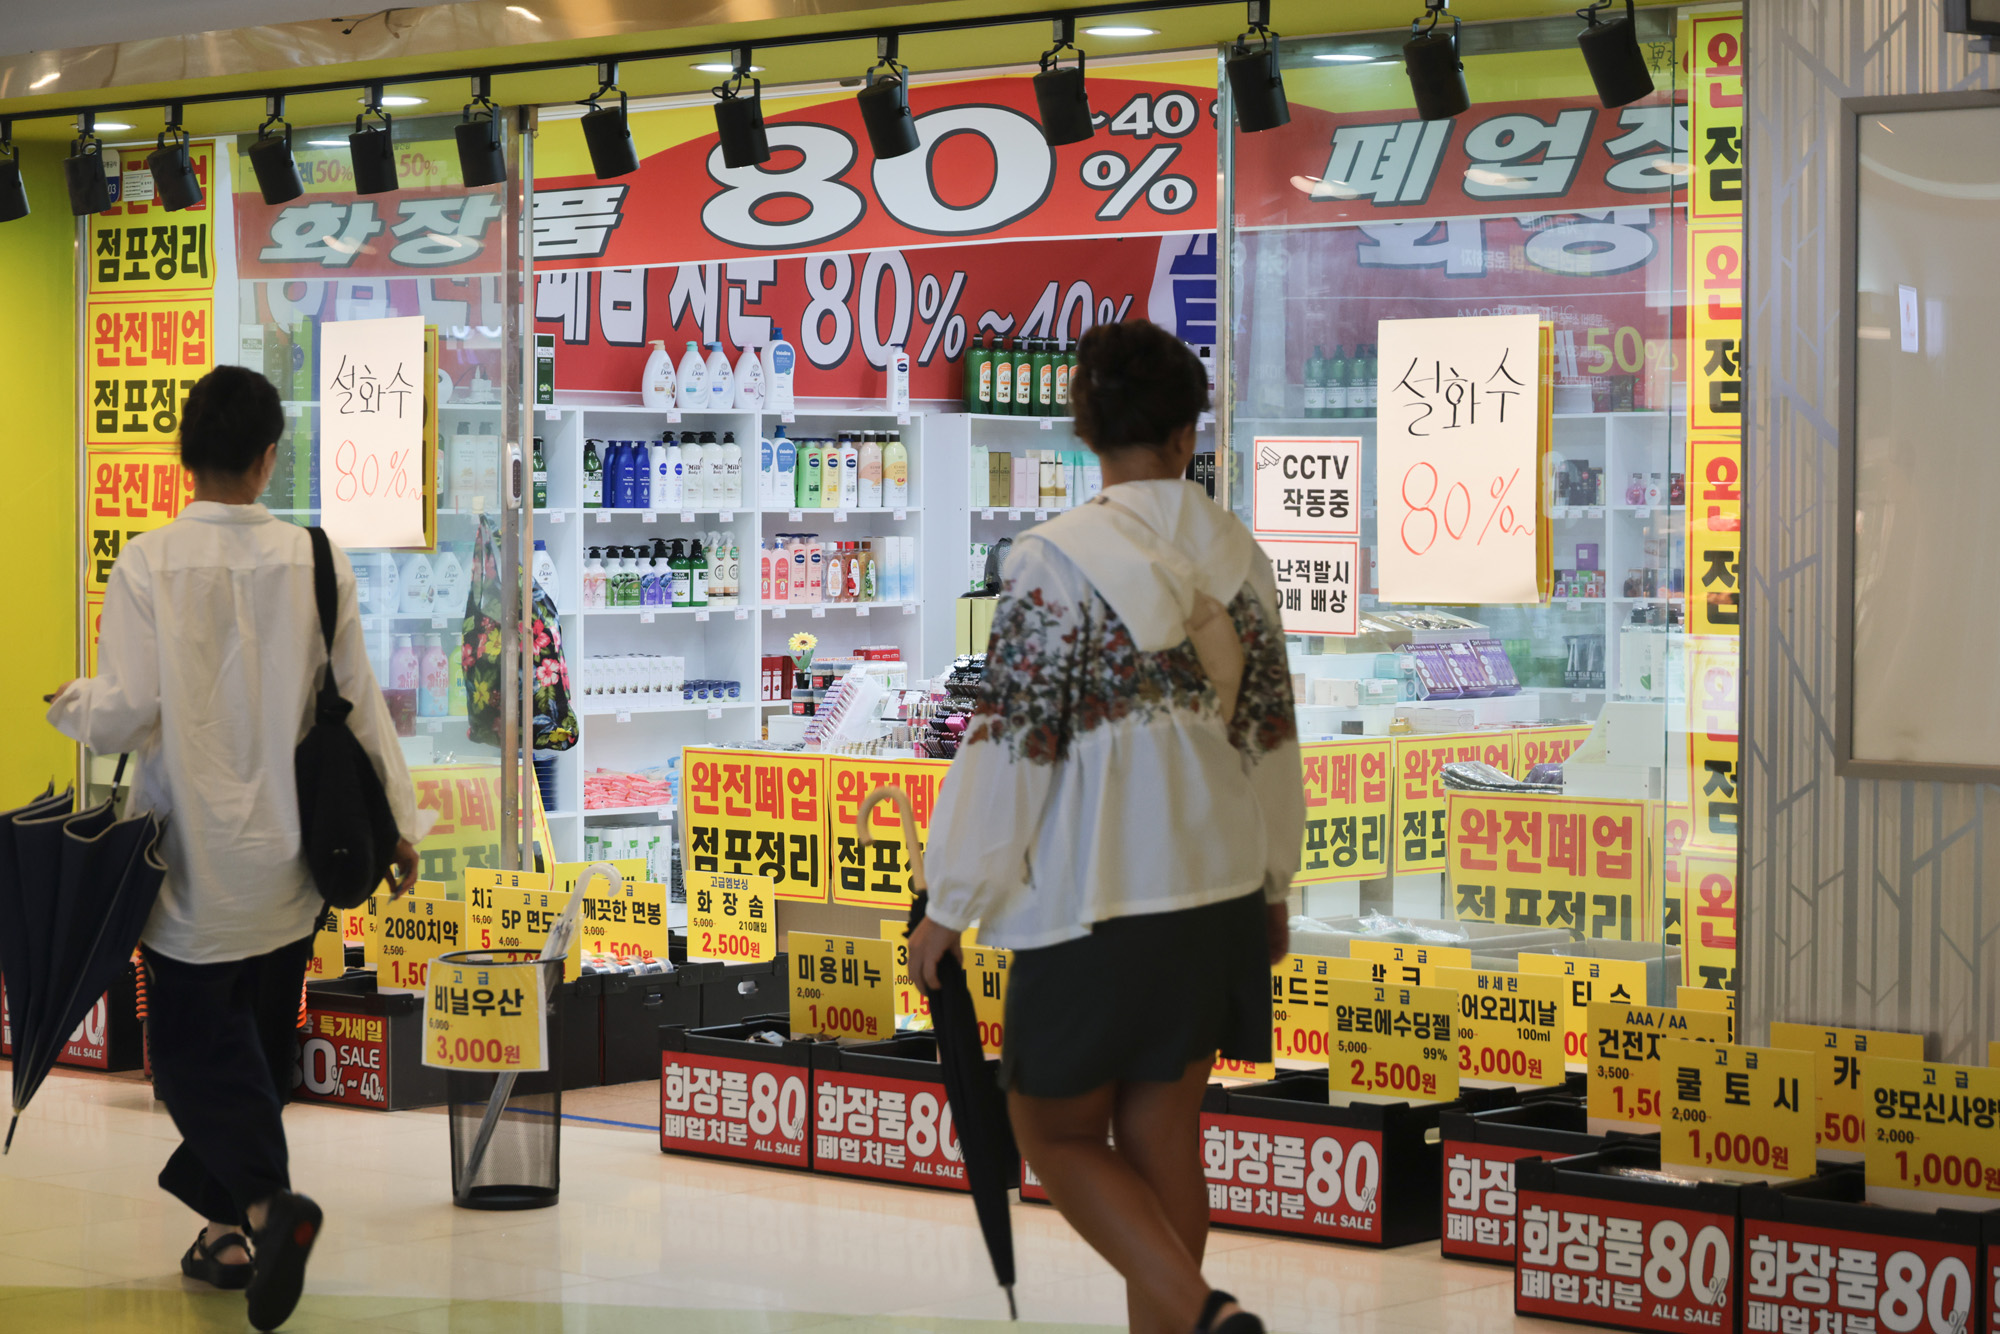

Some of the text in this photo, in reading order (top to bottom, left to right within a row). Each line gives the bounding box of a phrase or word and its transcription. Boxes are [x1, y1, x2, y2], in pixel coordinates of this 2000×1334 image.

[399, 153, 438, 178] 50%
[96, 224, 208, 282] 점포정리
[95, 310, 206, 367] 완전폐업
[1587, 326, 1679, 374] 50%
[330, 354, 414, 419] 설화수
[1391, 347, 1527, 437] 설화수
[94, 378, 200, 434] 점포정
[1283, 455, 1349, 480] CCTV
[1283, 488, 1349, 518] 작동중
[1270, 559, 1349, 584] 난적발시
[1311, 588, 1347, 613] 배상
[691, 761, 818, 822] 완전폐업
[836, 770, 947, 829] 완전폐
[691, 825, 819, 888] 점포정리
[1457, 807, 1633, 881] 완전폐업
[710, 875, 749, 891] 고급엠보싱
[502, 909, 564, 934] 5P 면도
[582, 898, 661, 926] 깨끗한 면봉
[693, 918, 767, 933] 5,000 210매입
[385, 917, 459, 947] 2080치약
[498, 937, 520, 947] 4,000
[583, 925, 605, 936] 3,000
[702, 931, 761, 960] 2,500원
[384, 945, 404, 956] 2,500
[798, 953, 882, 989] 미용비누
[435, 985, 525, 1017] 비닐우산
[796, 986, 822, 1000] 2,000
[808, 1003, 878, 1036] 1,000원
[1335, 1004, 1451, 1042] 알로에수딩젤
[1457, 993, 1557, 1027] 어오리지날
[1625, 1010, 1653, 1027] AAA
[1668, 1014, 1688, 1030] AA
[319, 1015, 384, 1043] 특가세일
[1516, 1027, 1551, 1042] 100ml
[68, 1045, 102, 1060] ALL SALE
[339, 1045, 382, 1070] SALE
[437, 1035, 521, 1065] 3,000원
[1338, 1040, 1448, 1061] 5,000 99%
[1459, 1044, 1543, 1080] 3,000원
[1350, 1059, 1437, 1095] 2,500원
[1597, 1065, 1630, 1080] 3,500
[665, 1062, 748, 1119] 화장품
[817, 1082, 906, 1141] 화장품
[1671, 1107, 1708, 1123] 2,000
[1874, 1087, 2000, 1129] 양모신사양
[664, 1113, 748, 1148] 폐업처분
[1876, 1128, 1915, 1144] 2,000
[753, 1140, 801, 1157] ALL SALE
[816, 1134, 906, 1169] 폐업처분
[1203, 1125, 1306, 1189] 화장품
[1687, 1128, 1790, 1171] 1,000원
[912, 1163, 964, 1180] ALL SALE
[1895, 1150, 2000, 1192] 1,000원
[1207, 1183, 1306, 1220] 폐업처분
[1313, 1210, 1373, 1231] ALL SALE
[1521, 1204, 1644, 1279] 화장품
[1747, 1233, 1879, 1311] 화장품
[1520, 1268, 1643, 1313] 폐업처분
[1651, 1304, 1722, 1326] ALL SALE
